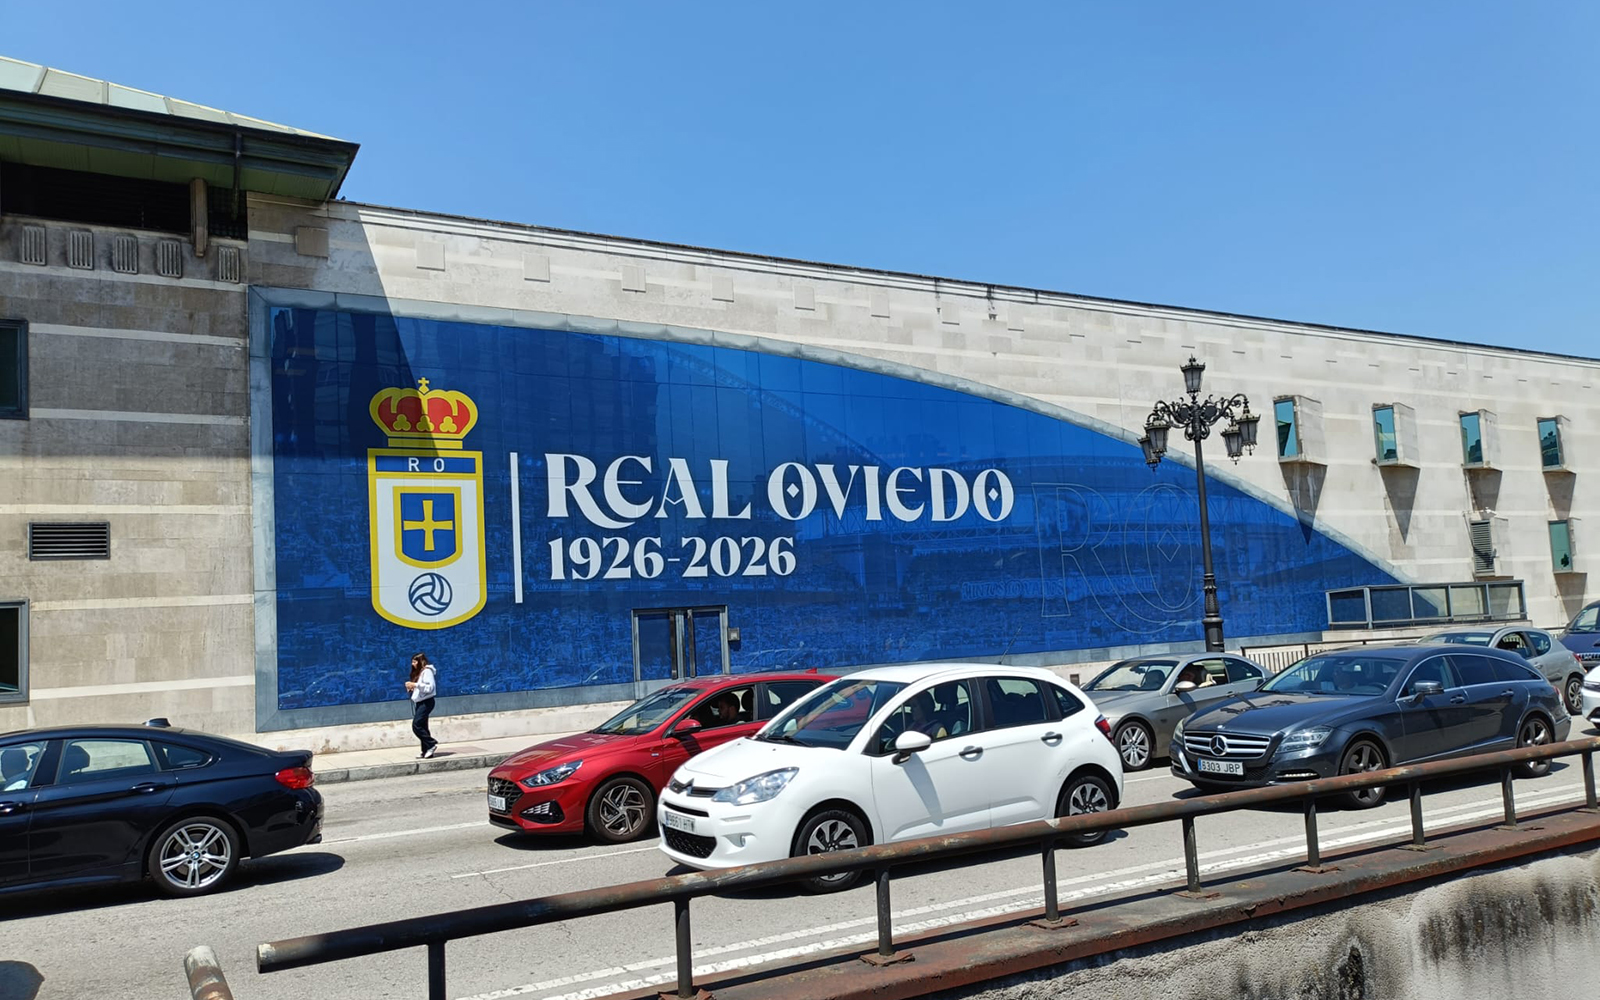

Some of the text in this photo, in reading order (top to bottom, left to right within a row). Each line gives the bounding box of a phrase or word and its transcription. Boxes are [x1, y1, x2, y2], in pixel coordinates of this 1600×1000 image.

[545, 453, 1014, 529] REAL OVIEDO
[548, 536, 797, 580] 1926-2026
[1224, 763, 1240, 773] JBP
